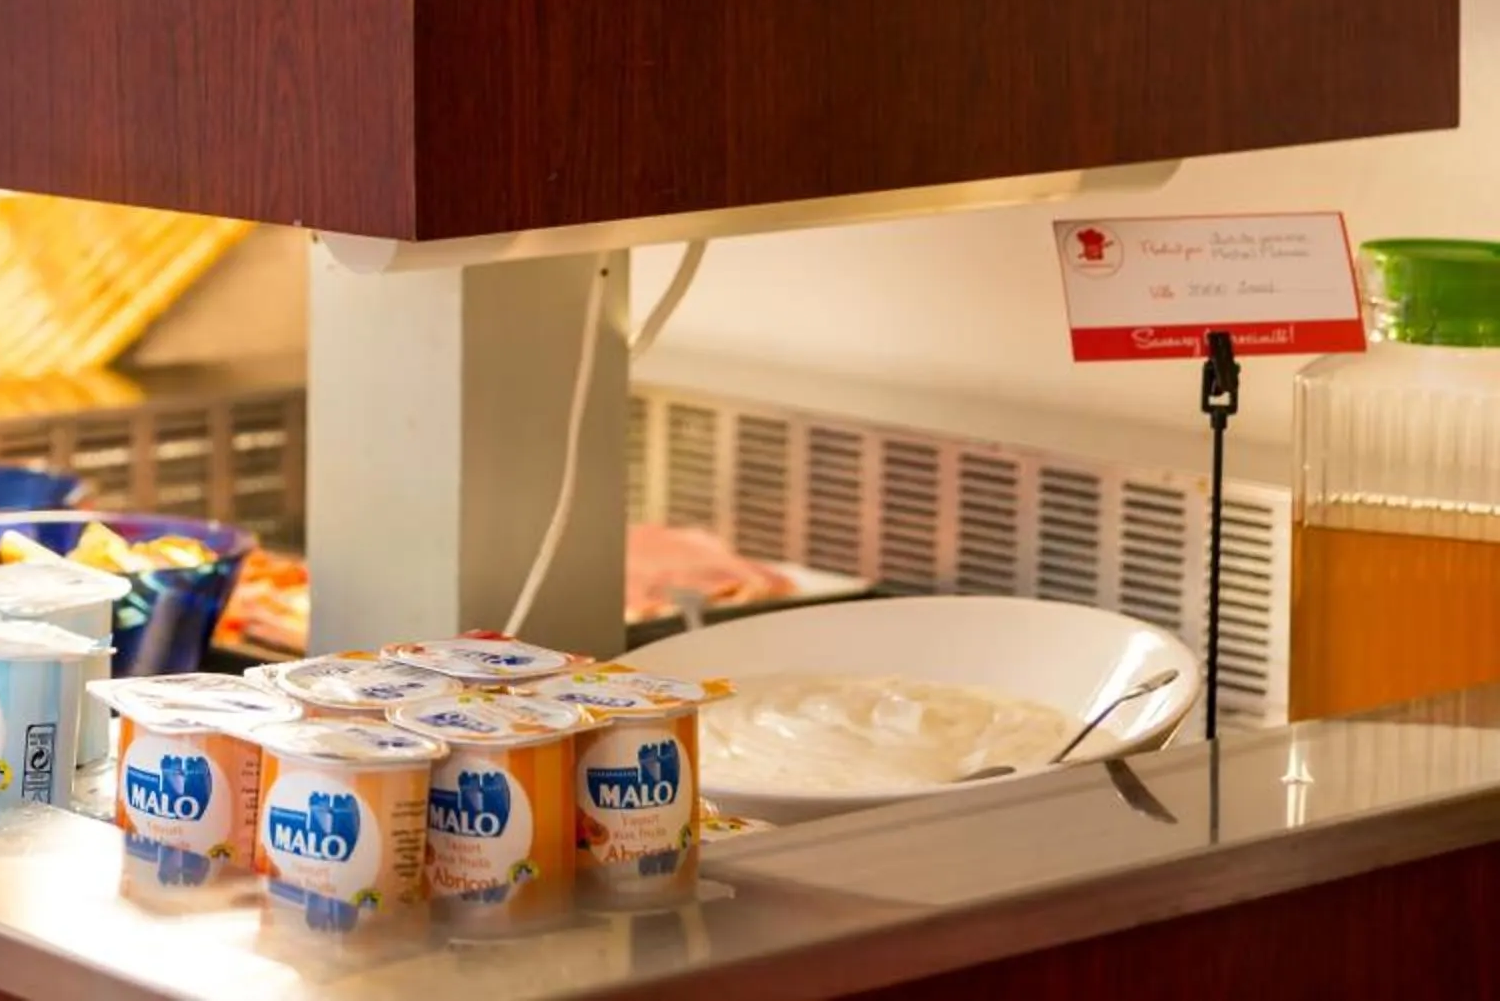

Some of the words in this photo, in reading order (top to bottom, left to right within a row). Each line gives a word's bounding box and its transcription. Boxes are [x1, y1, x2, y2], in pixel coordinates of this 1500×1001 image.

[131, 783, 200, 819] MALO
[599, 781, 673, 807] MALO
[430, 806, 501, 837] MALO
[274, 822, 348, 860] MALO
[433, 866, 499, 891] Abricot
